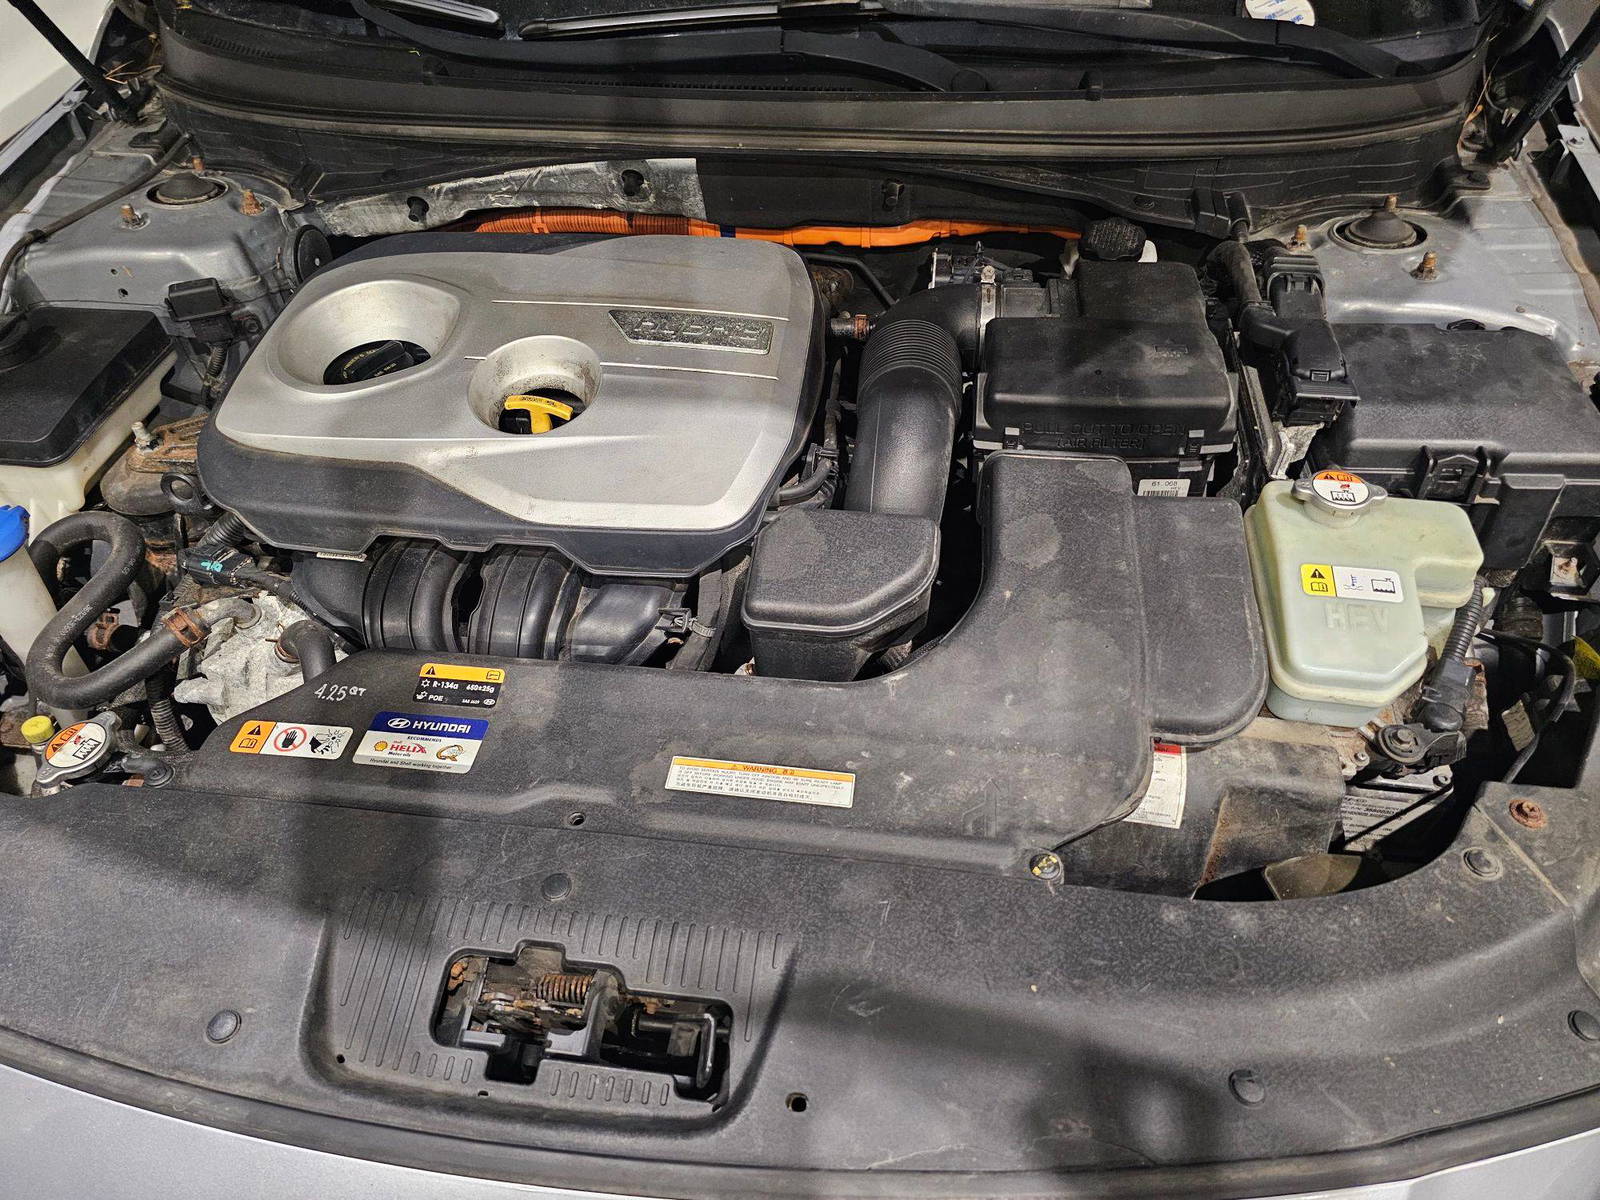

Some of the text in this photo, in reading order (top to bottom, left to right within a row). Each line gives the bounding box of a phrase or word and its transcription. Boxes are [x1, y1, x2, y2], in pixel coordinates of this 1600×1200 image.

[314, 683, 348, 701] 4.25
[428, 694, 444, 702] POE
[412, 720, 472, 734] HYUNDAI
[407, 735, 442, 743] RECOMMENDS
[390, 743, 427, 754] HELIX
[743, 765, 777, 774] WARNING
